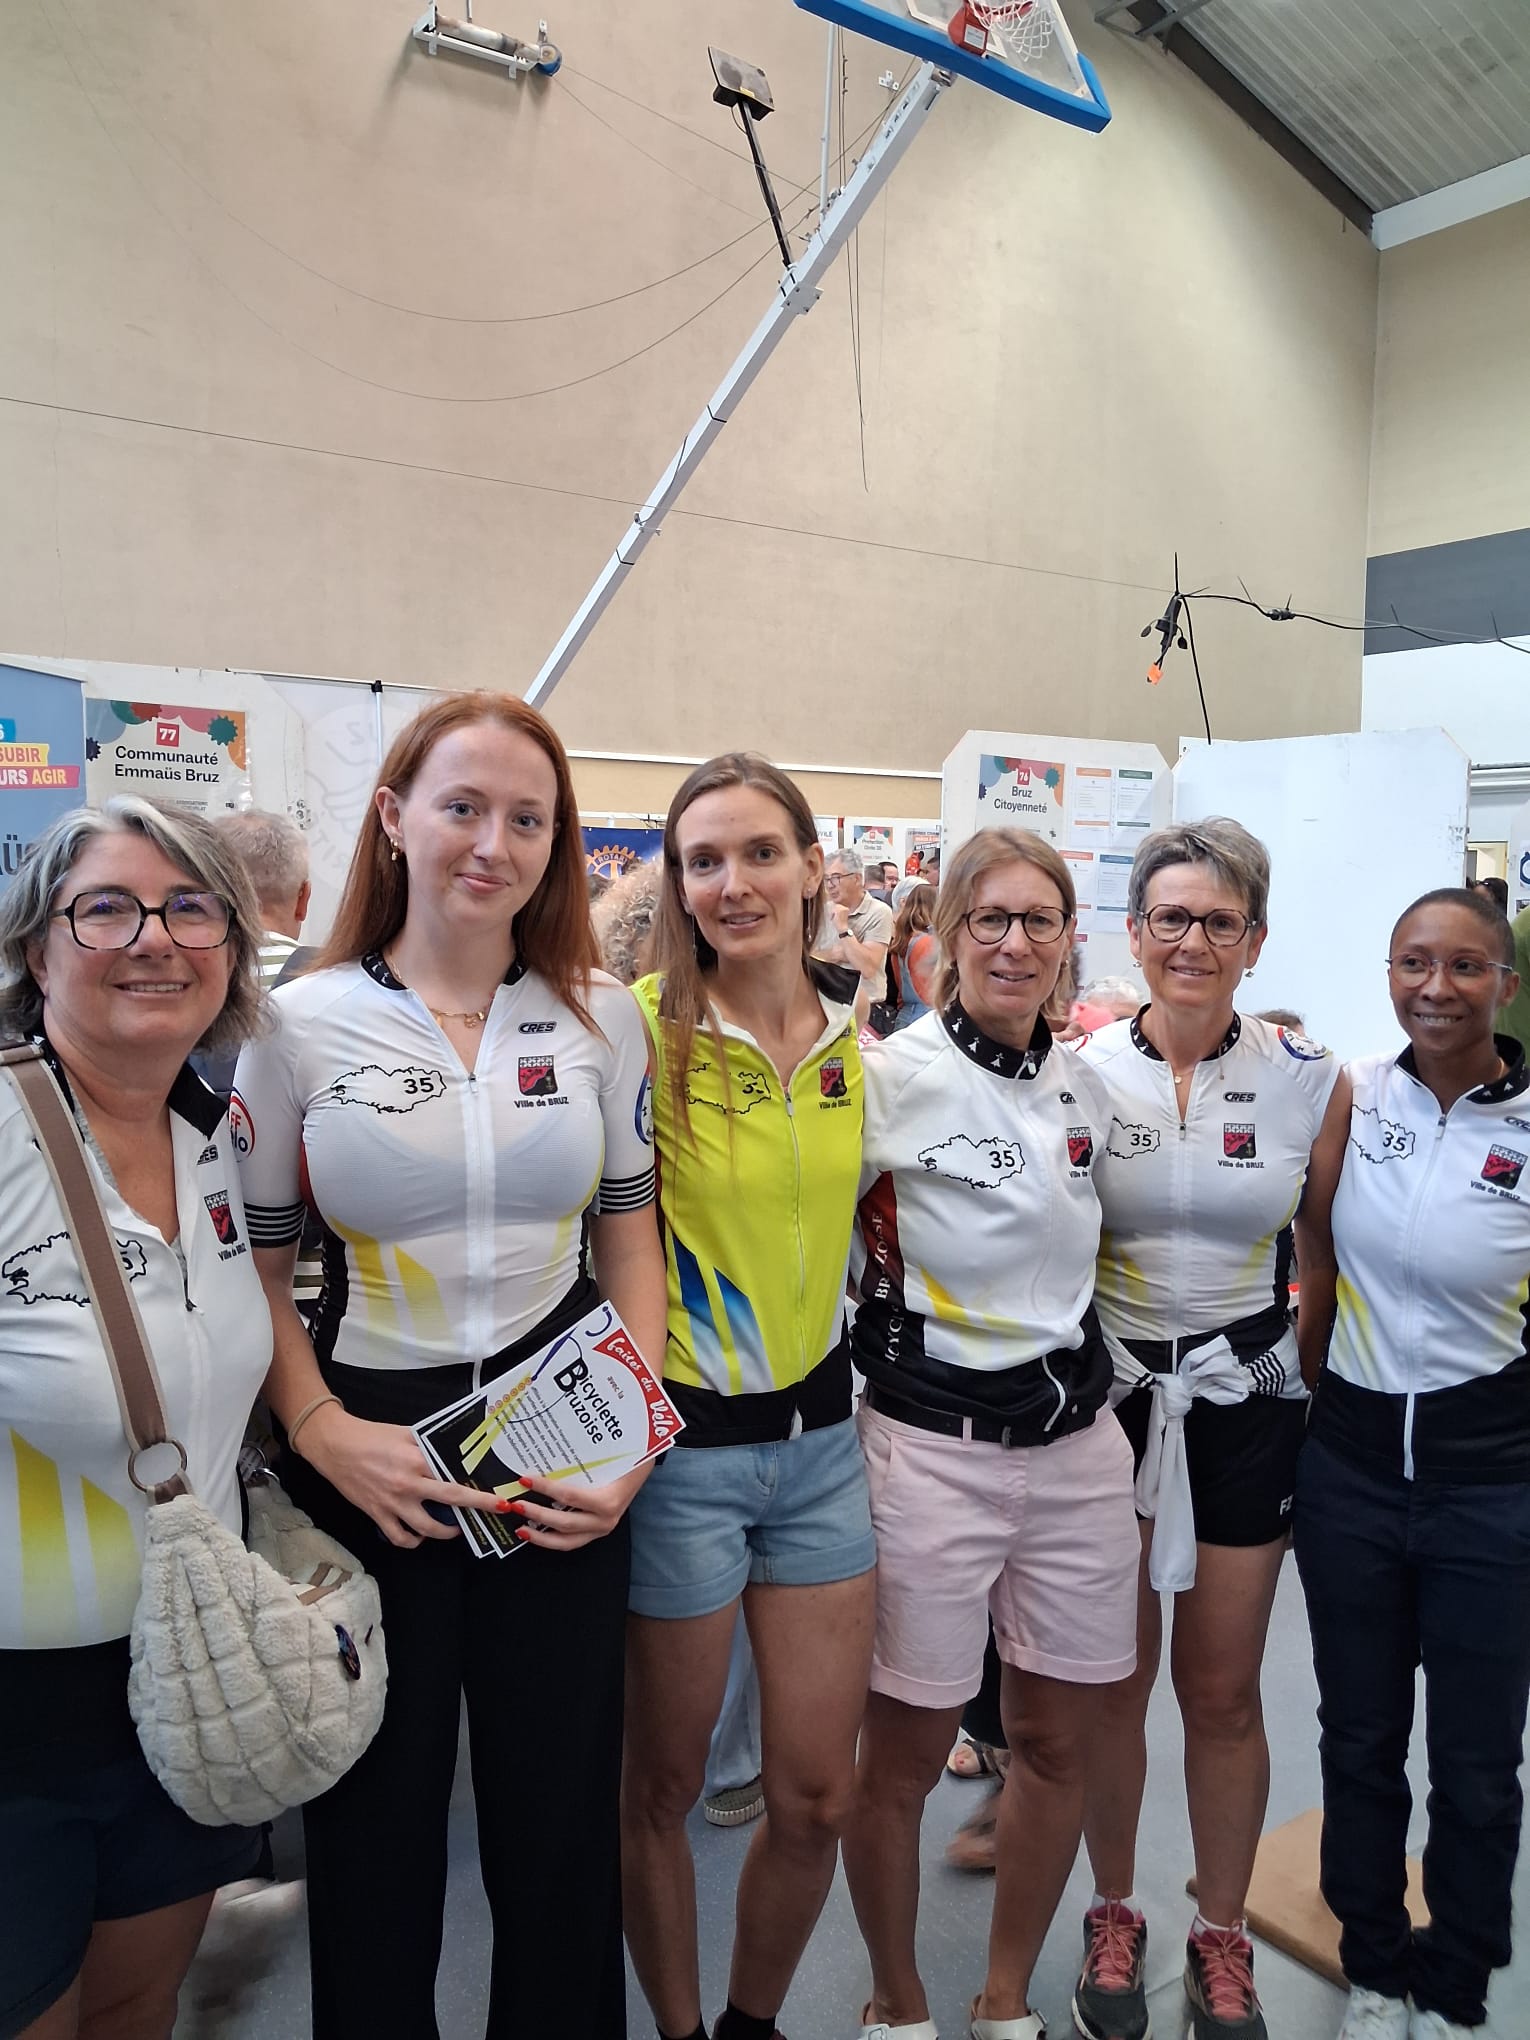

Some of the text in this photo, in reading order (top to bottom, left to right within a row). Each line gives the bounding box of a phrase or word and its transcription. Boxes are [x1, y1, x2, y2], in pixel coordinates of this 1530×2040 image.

[159, 728, 177, 742] 77
[115, 745, 219, 765] Communauté
[0, 768, 67, 785] URS AGIR
[114, 763, 220, 783] Emmaüs Bruz
[1019, 771, 1029, 782] 76
[1011, 786, 1033, 798] Bruz
[994, 798, 1048, 814] Citoyenneté
[519, 1022, 556, 1034] CRES
[402, 1077, 435, 1095] 35
[514, 1097, 569, 1109] Ville de BRUZ
[1060, 1092, 1076, 1104] CR
[1224, 1092, 1256, 1103] CRES
[1130, 1133, 1152, 1147] 35
[1382, 1131, 1407, 1152] 35
[988, 1150, 1015, 1169] 35
[1217, 1159, 1265, 1169] Ville de BRUZ
[1470, 1180, 1486, 1191] Ville
[1488, 1186, 1497, 1195] de
[606, 1375, 625, 1400] avec la
[555, 1357, 623, 1441] Bicyclette
[640, 1376, 654, 1393] du
[649, 1398, 674, 1439] Vélo
